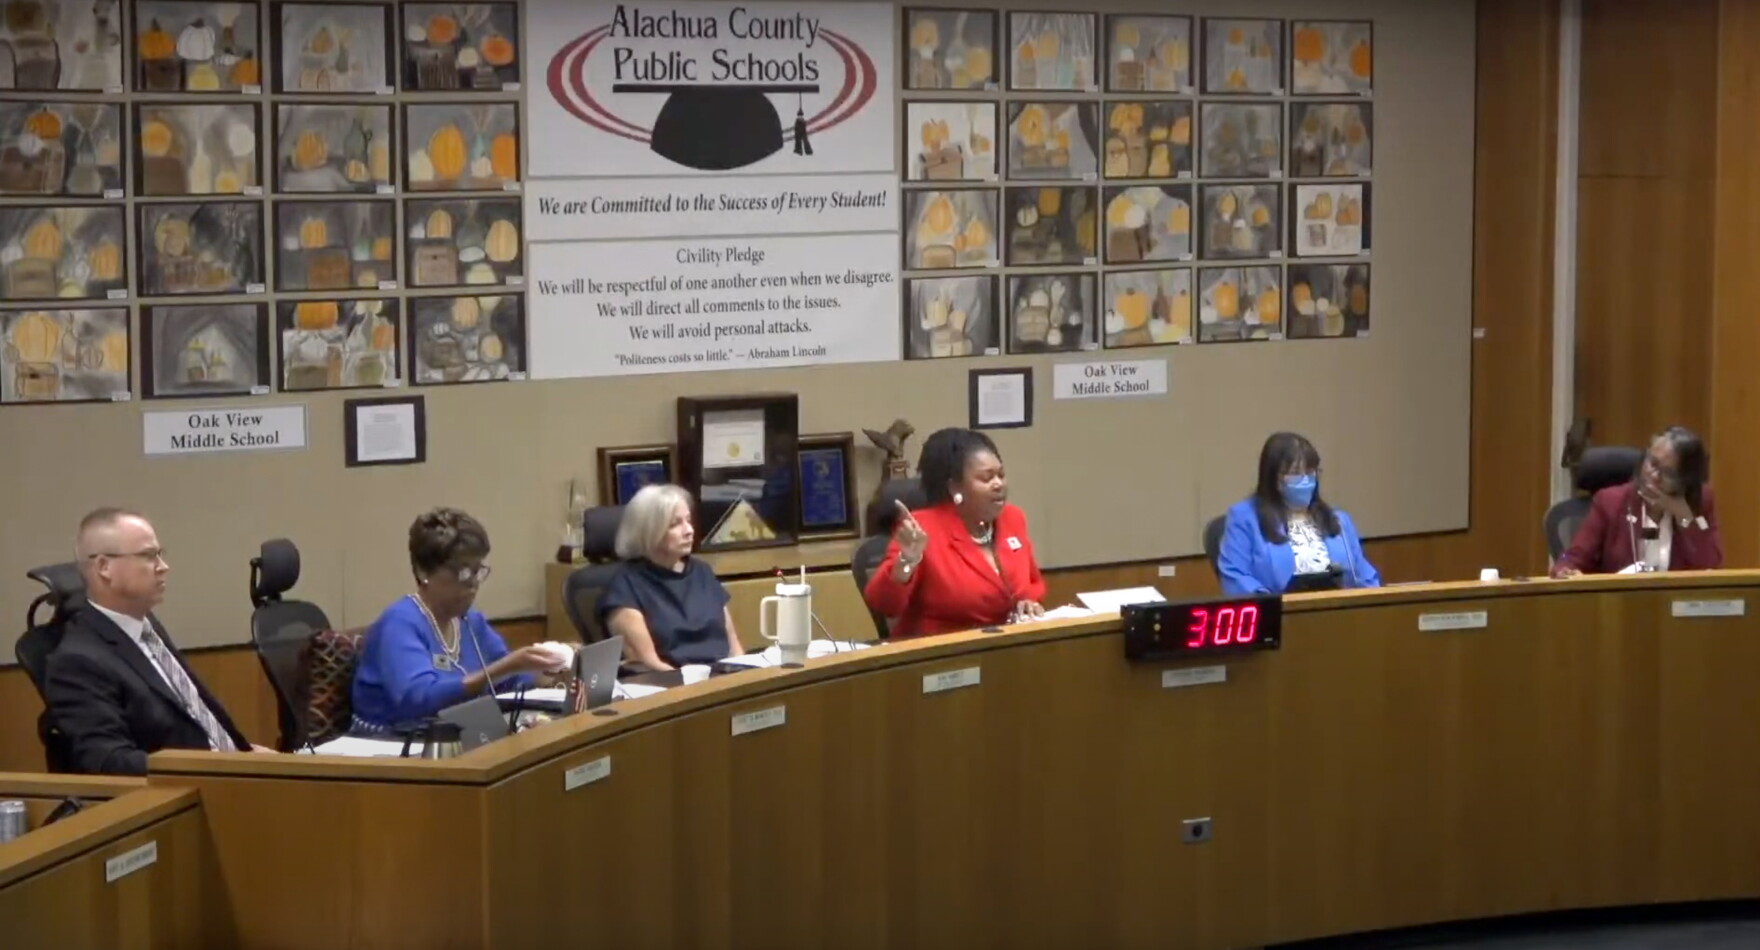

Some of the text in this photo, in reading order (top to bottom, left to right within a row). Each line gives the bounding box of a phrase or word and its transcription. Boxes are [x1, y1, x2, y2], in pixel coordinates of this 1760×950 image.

[608, 5, 819, 48] Alachua County
[613, 47, 819, 81] Public Schools
[538, 191, 887, 215] We are Committed to the Success of Every Student!
[676, 247, 765, 267] Civility Pledge
[538, 269, 894, 297] We will be respectful of one another even when we disagree.
[597, 294, 841, 317] We will direct all comments to the issues.
[629, 318, 812, 340] We will avoid personal attacks.
[668, 351, 692, 363] costs
[694, 352, 704, 362] so
[748, 346, 789, 360] Abraham
[792, 345, 827, 357] Lincoln
[1084, 364, 1138, 377] Oak View
[1072, 380, 1149, 395] Middle School
[188, 412, 262, 428] Oak View
[170, 431, 280, 449] Middle School
